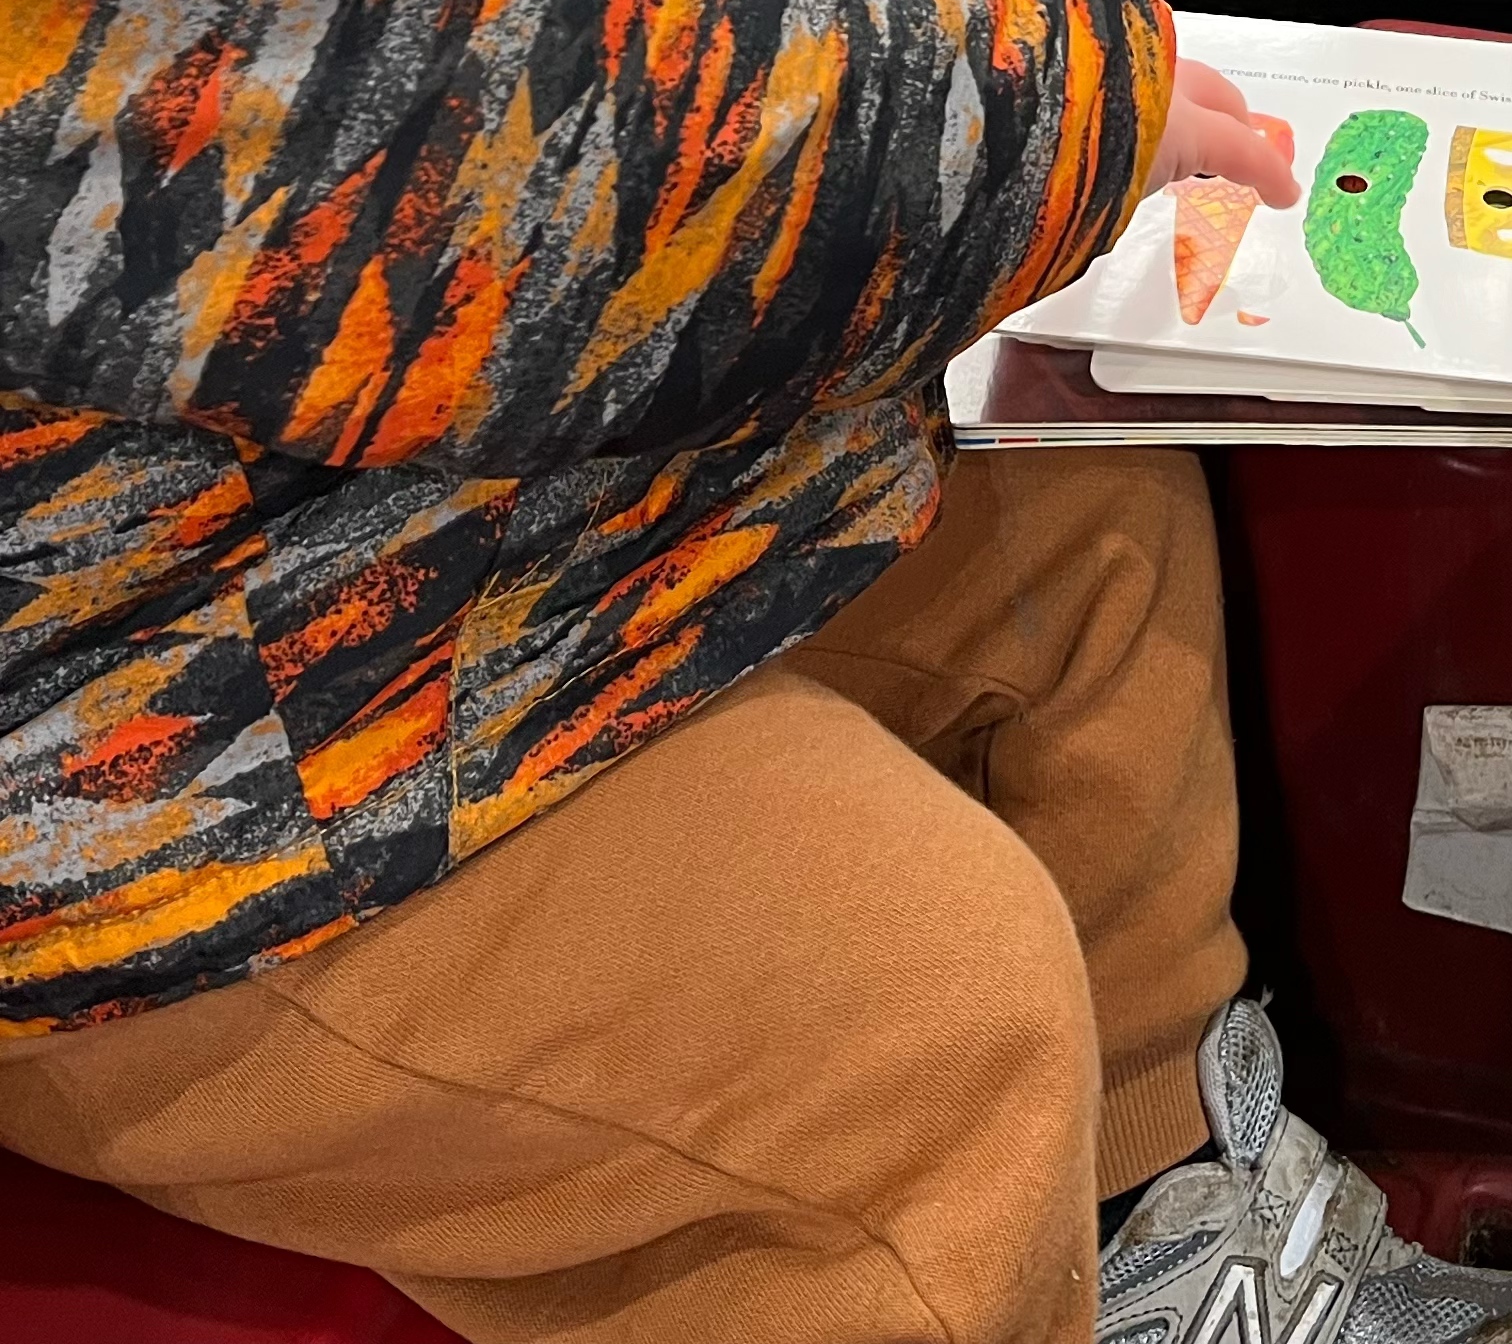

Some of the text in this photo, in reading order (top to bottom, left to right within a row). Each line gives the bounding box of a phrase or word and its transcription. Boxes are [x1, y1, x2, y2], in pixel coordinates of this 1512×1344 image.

[1271, 72, 1308, 83] cone,
[1313, 76, 1339, 86] one
[1343, 78, 1391, 92] pickle,
[1395, 85, 1422, 94] one
[1426, 86, 1458, 98] slice
[1461, 89, 1476, 100] of
